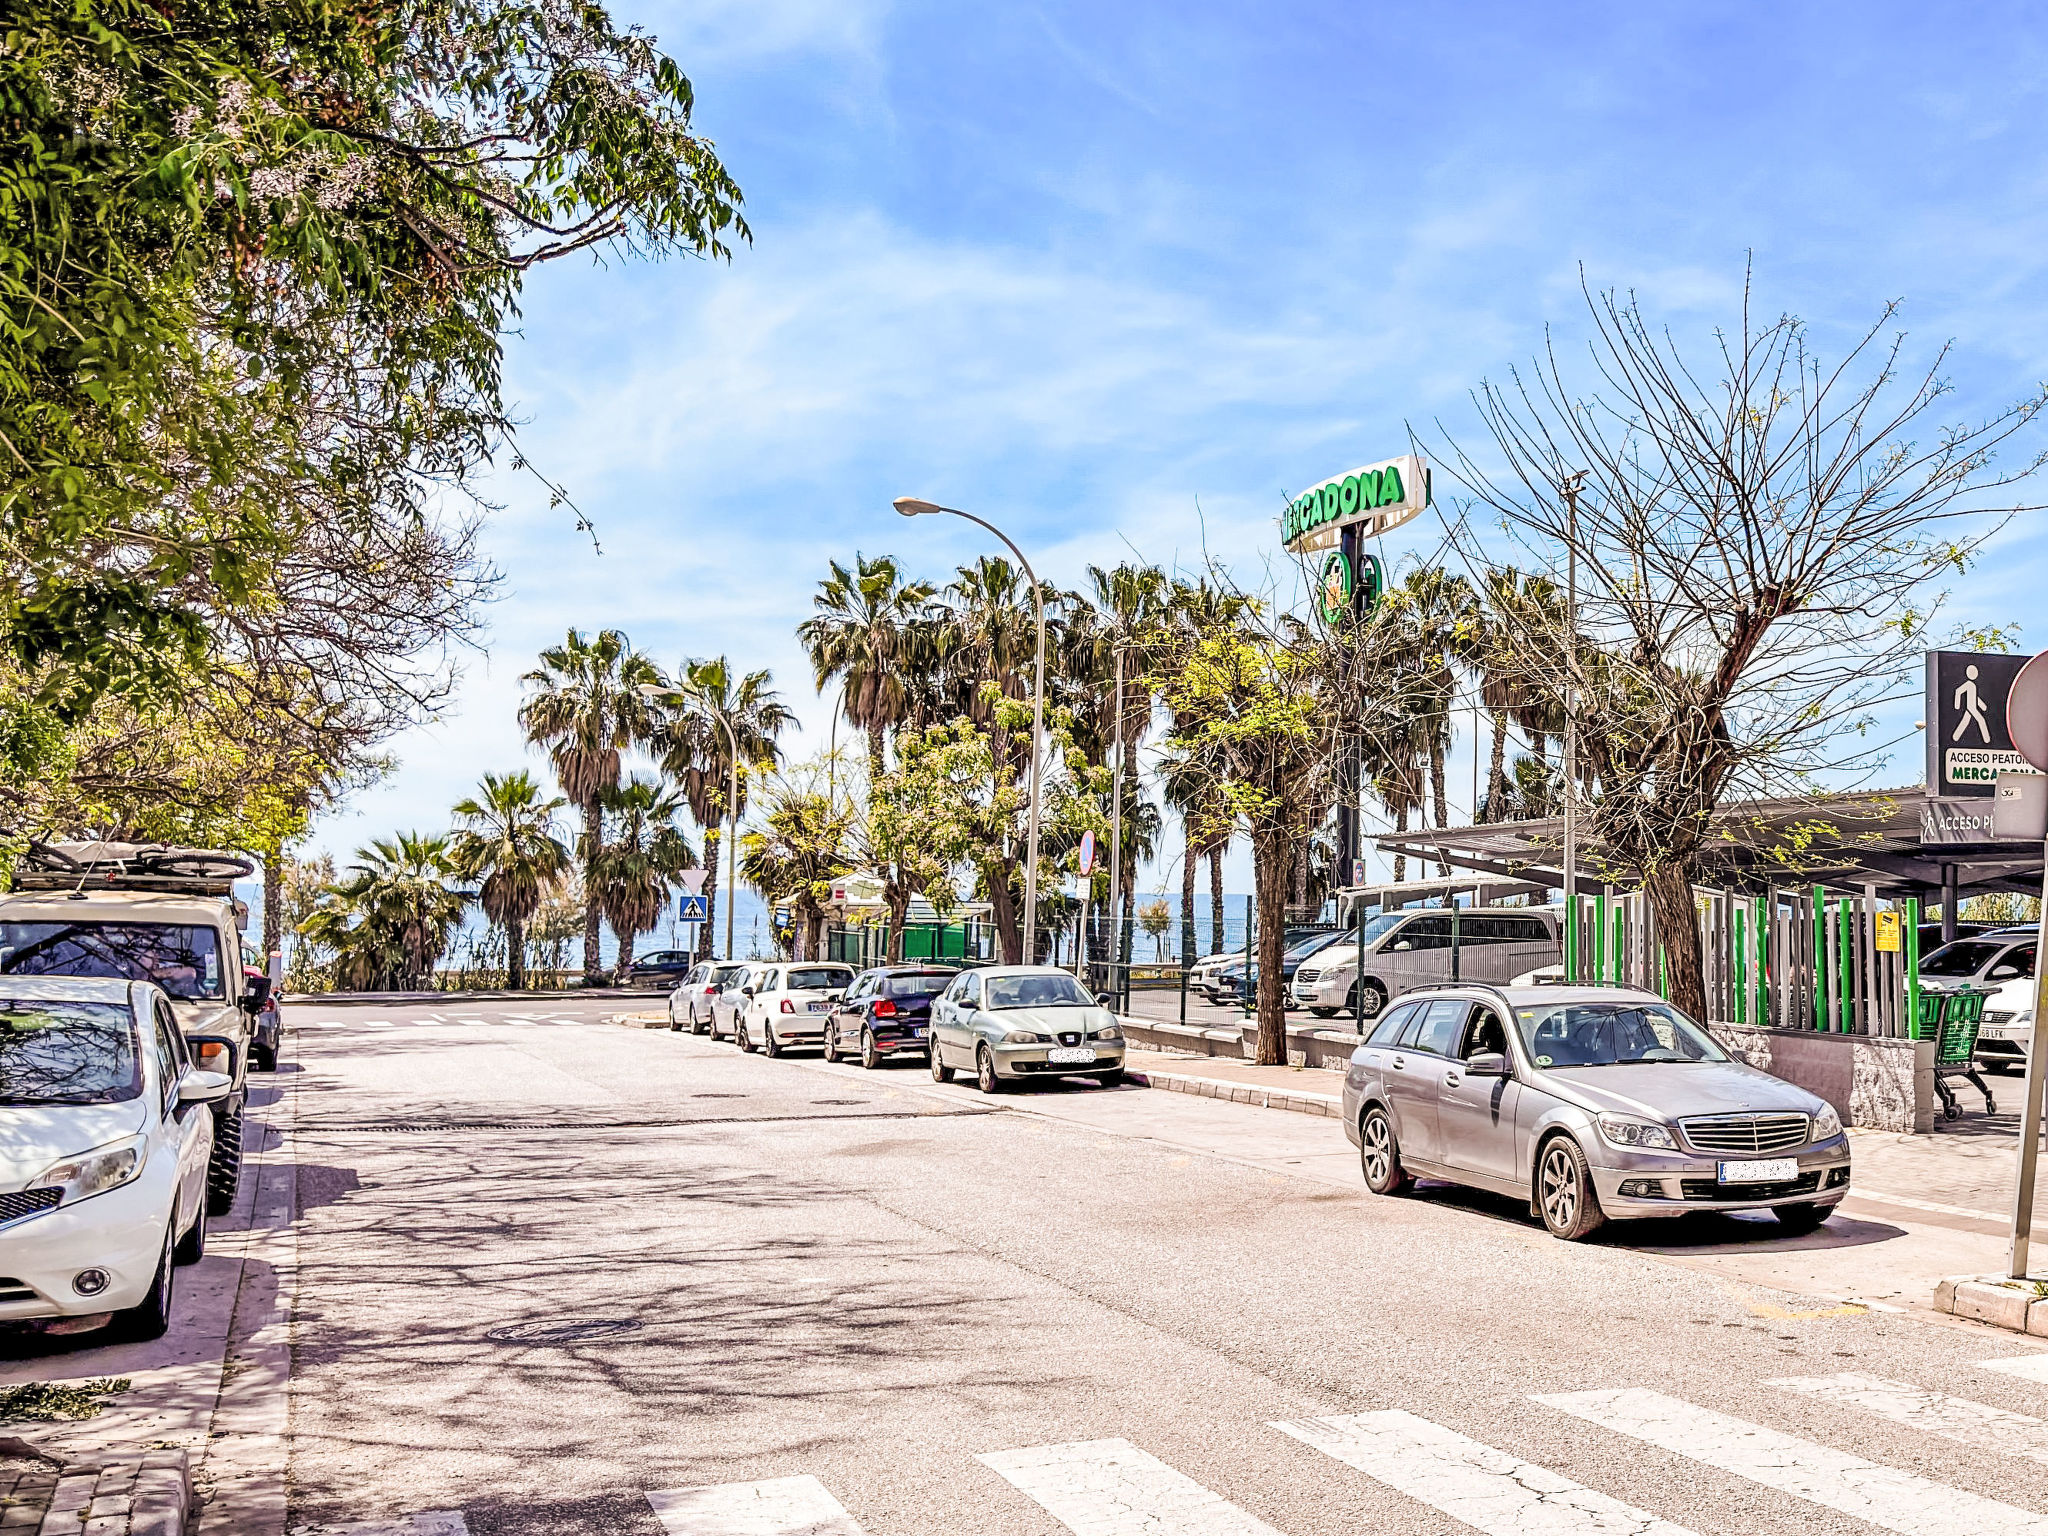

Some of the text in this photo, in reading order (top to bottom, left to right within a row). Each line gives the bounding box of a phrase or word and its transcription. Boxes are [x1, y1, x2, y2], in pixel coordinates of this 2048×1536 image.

[1950, 752, 1989, 764] ACCESO
[1939, 815, 1980, 831] ACCESO
[1991, 1029, 2003, 1039] LFK
